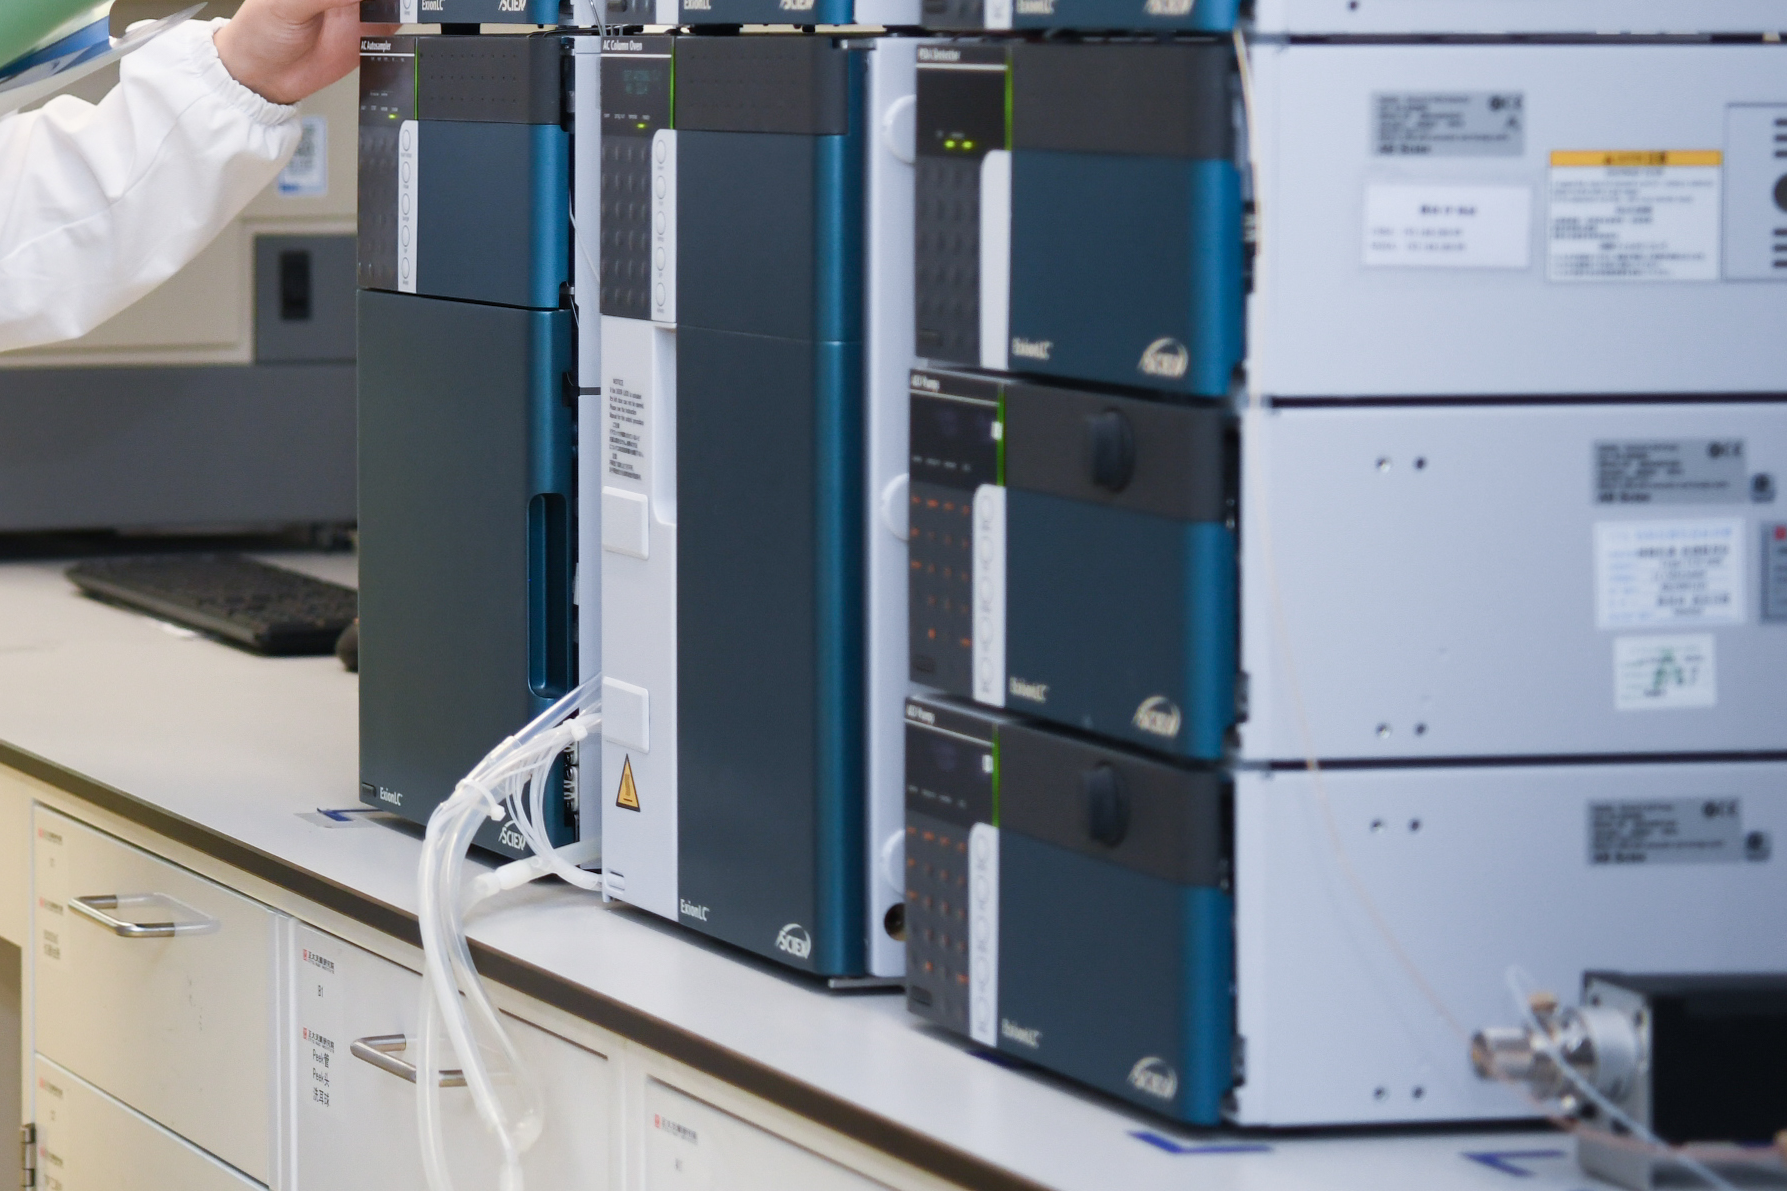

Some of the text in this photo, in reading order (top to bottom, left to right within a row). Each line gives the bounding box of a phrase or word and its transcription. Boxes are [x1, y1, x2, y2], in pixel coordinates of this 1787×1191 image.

[367, 40, 392, 52] Autosampler
[603, 39, 643, 51] AC Column Oven
[379, 787, 402, 807] ExionLC
[500, 825, 527, 851] SCIEX
